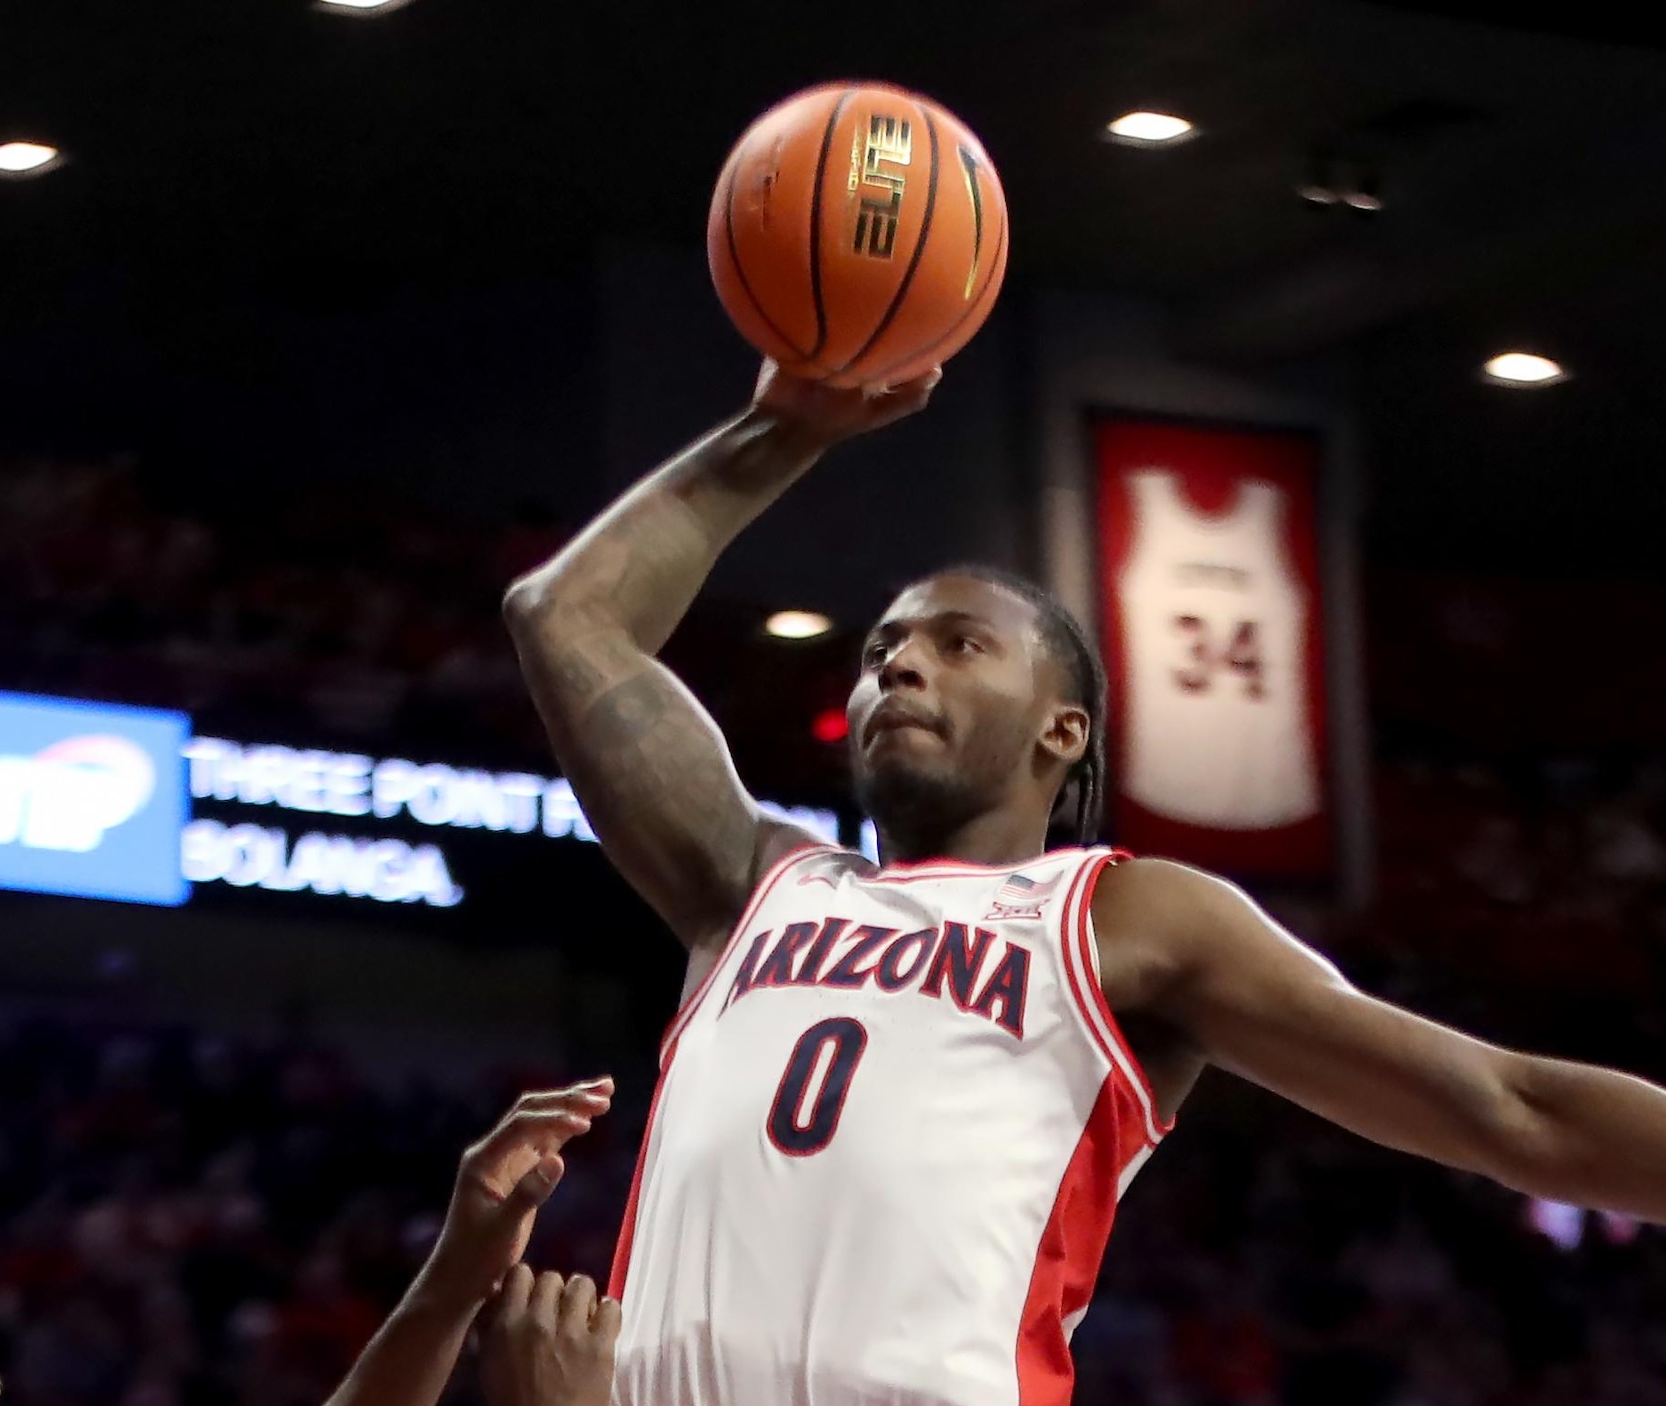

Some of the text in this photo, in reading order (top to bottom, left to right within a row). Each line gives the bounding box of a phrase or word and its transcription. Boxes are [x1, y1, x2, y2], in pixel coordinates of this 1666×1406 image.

[1171, 608, 1269, 702] 34
[181, 735, 374, 816] THREE
[372, 758, 544, 834] POINT
[718, 917, 1031, 1040] ARIZONA
[766, 1016, 869, 1158] 0
